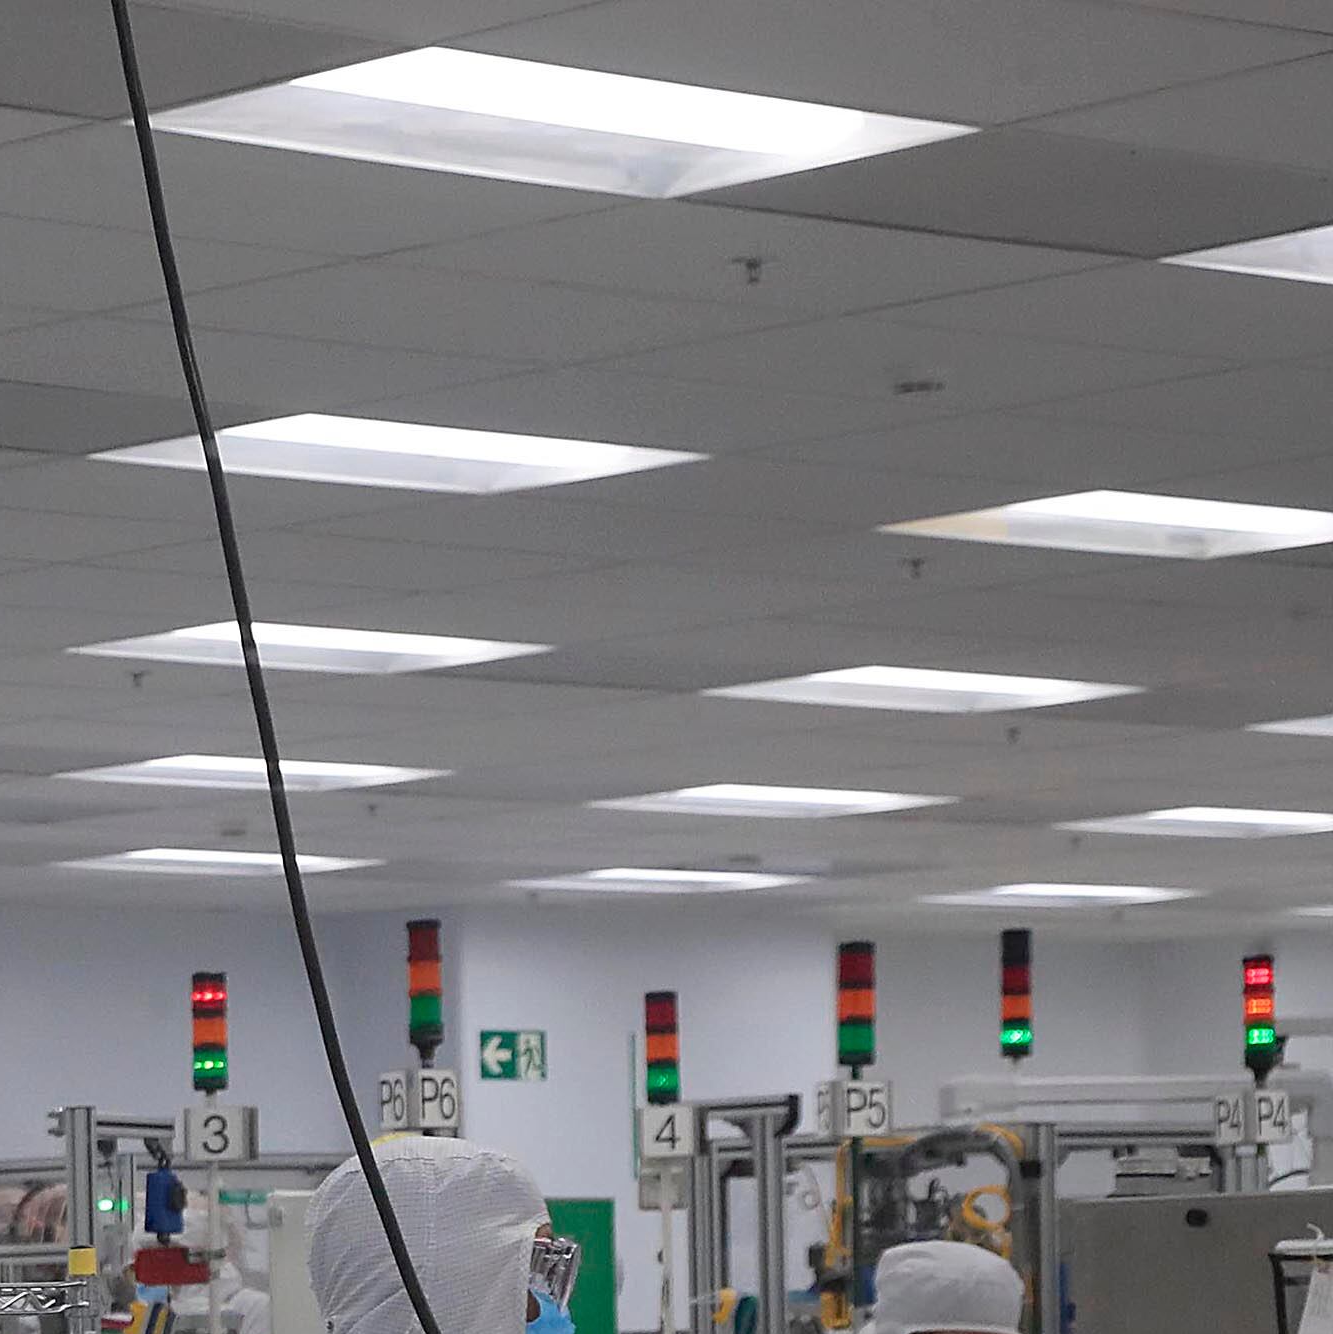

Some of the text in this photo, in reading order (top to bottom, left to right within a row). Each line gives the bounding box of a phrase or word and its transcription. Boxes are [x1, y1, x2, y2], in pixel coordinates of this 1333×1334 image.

[380, 1079, 405, 1120] P6
[421, 1077, 456, 1120] P6
[846, 1088, 886, 1129] P5
[1257, 1096, 1287, 1135] P4
[203, 1114, 229, 1154] 3
[655, 1114, 681, 1150] 4
